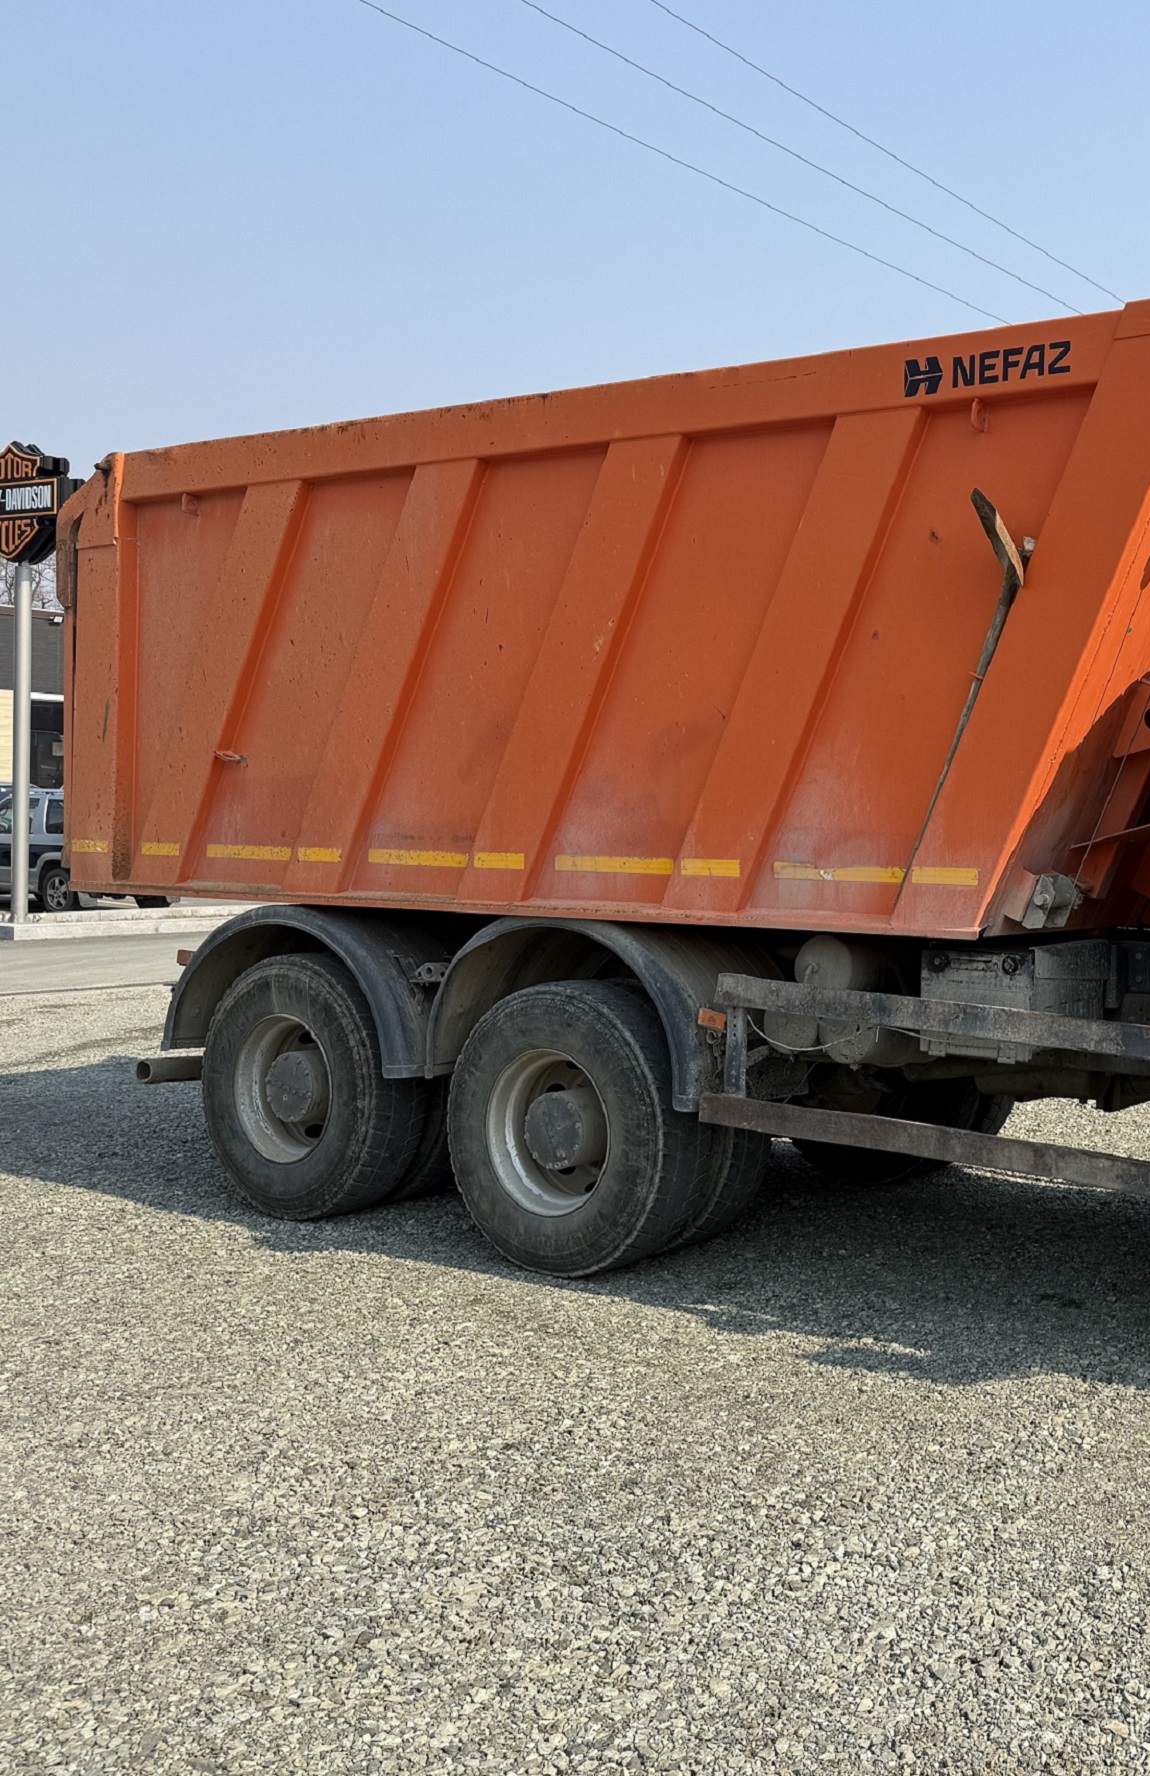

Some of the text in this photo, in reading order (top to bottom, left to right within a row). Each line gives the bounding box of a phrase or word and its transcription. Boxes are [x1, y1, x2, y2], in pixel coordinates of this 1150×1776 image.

[952, 341, 1071, 388] NEFAZ
[0, 485, 52, 511] -DAVIDSON
[0, 519, 31, 553] CLES
